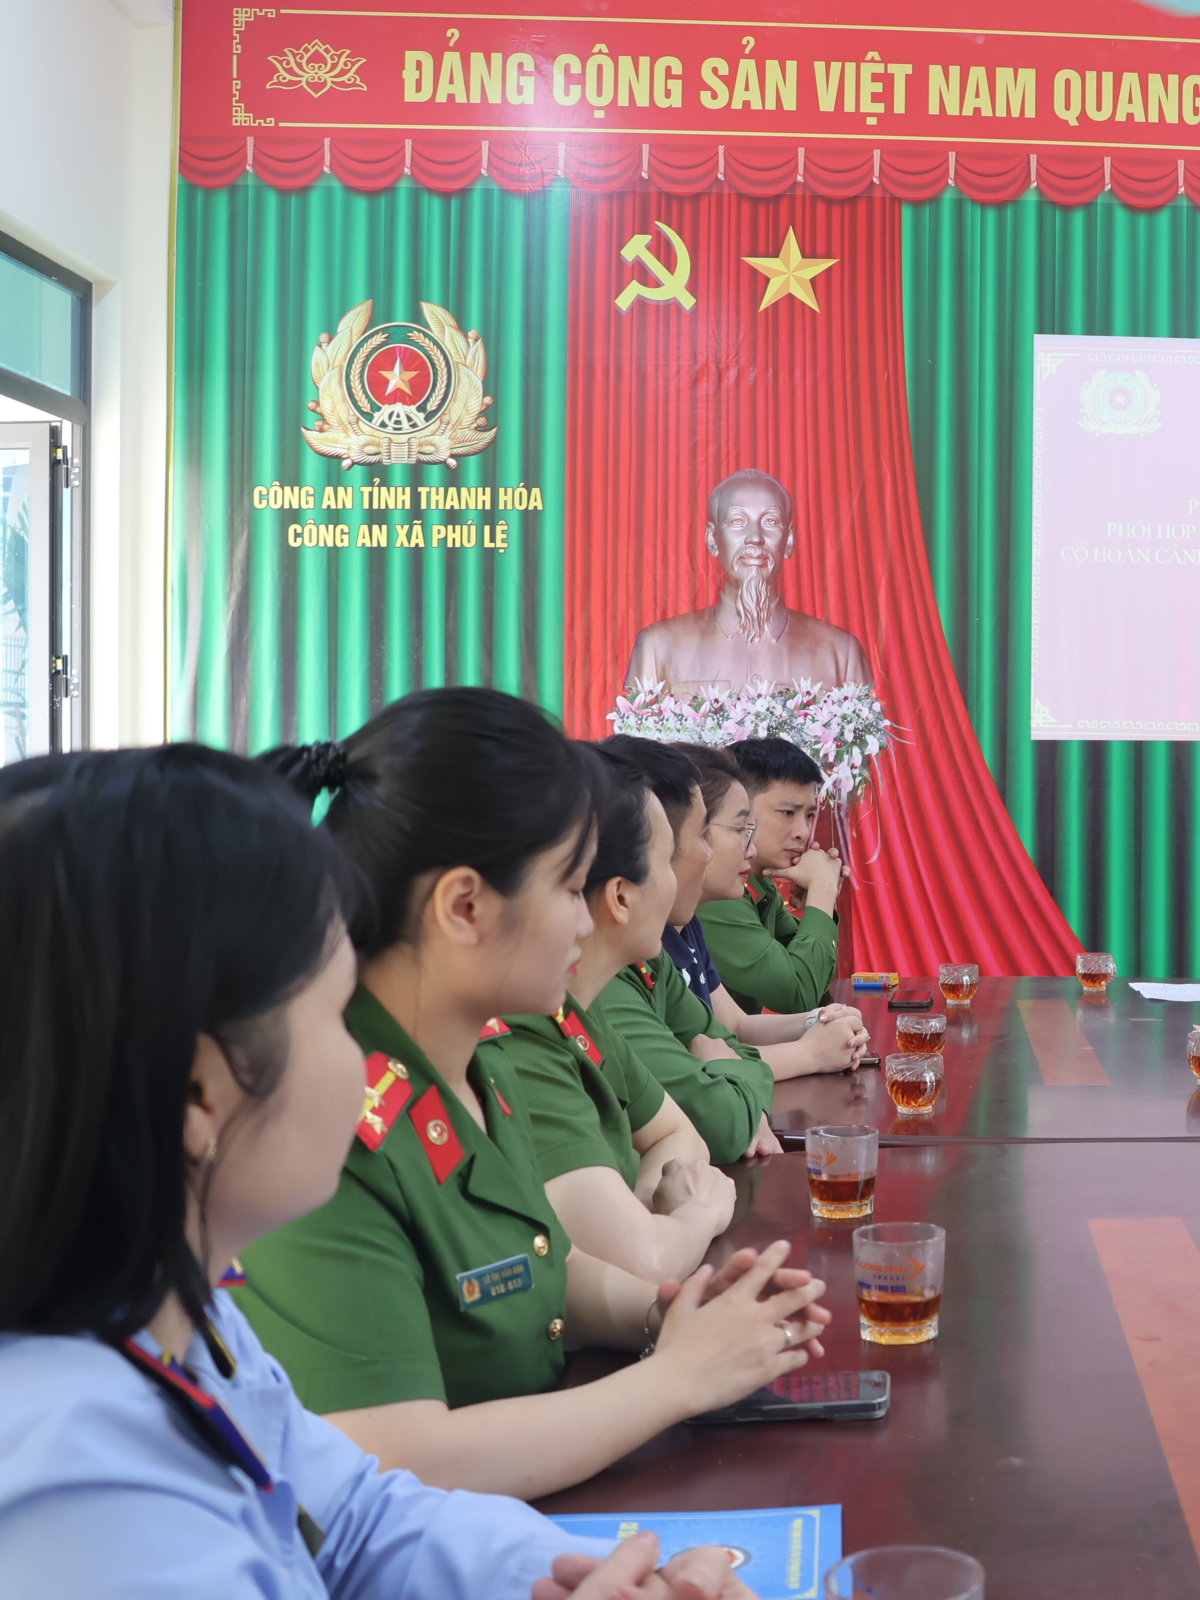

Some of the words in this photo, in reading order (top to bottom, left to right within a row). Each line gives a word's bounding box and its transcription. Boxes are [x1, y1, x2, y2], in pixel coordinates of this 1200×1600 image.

[402, 27, 535, 104] ĐẢNG
[551, 42, 683, 119] CỘNG
[700, 35, 797, 111] SẢN
[813, 51, 913, 125] VIỆT
[928, 64, 1036, 119] NAM
[253, 481, 316, 510] CÔNG
[321, 486, 354, 510] AN
[359, 477, 411, 510] TỈNH
[417, 486, 493, 511] THANH
[498, 482, 544, 511] HÓA
[287, 519, 350, 548] CÔNG
[356, 523, 388, 548] AN
[394, 520, 425, 548] XÃ
[432, 520, 477, 548] PHÚ
[483, 520, 509, 554] LỆ
[1157, 523, 1196, 543] HỢP
[1060, 542, 1088, 563] CÓ
[1093, 543, 1150, 564] HOÀN
